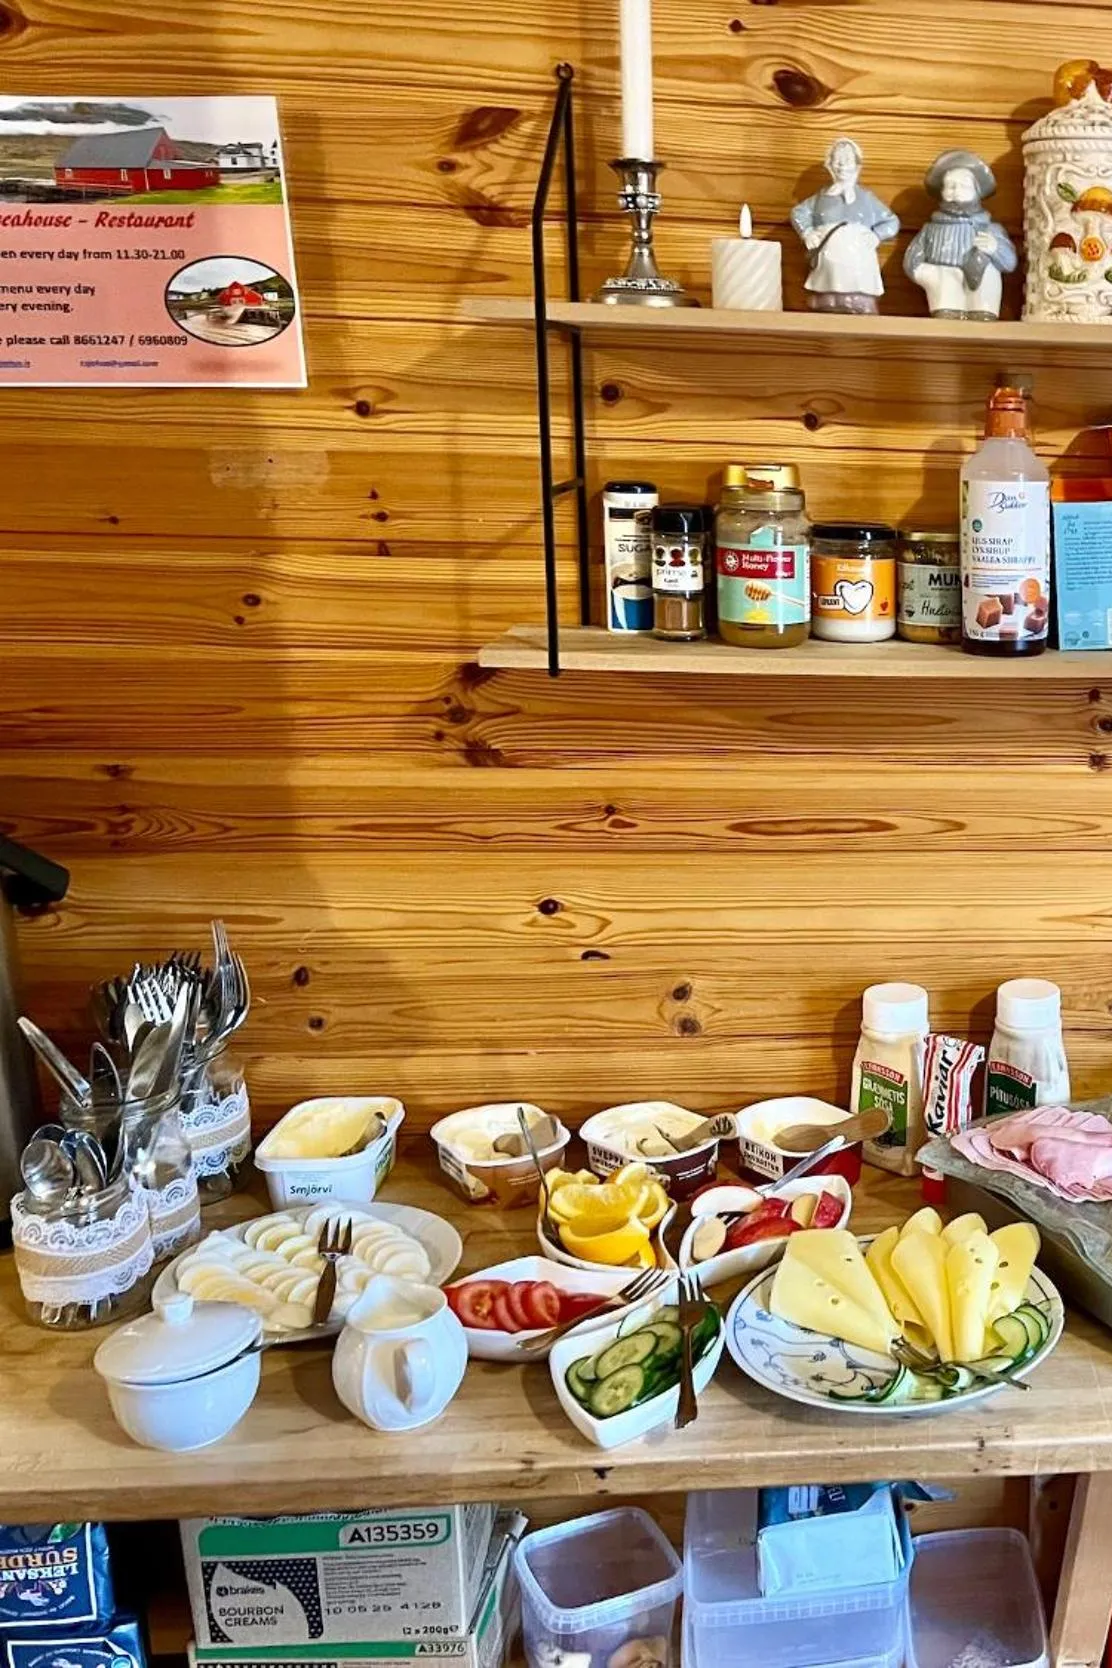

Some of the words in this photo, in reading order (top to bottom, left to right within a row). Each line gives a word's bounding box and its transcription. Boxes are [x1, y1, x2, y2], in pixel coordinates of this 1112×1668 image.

[0, 209, 73, 228] eahouse
[95, 211, 195, 229] Restaurant
[20, 250, 54, 261] every
[57, 249, 79, 261] day
[83, 249, 112, 260] from
[117, 249, 186, 260] 11.30-21.00
[36, 285, 71, 296] every
[74, 283, 96, 296] day
[21, 302, 74, 313] evening.
[6, 335, 46, 347] please
[50, 335, 70, 345] call
[73, 335, 125, 346] 8661247
[138, 336, 188, 346] 6960809
[742, 563, 769, 572] Honey
[927, 1049, 954, 1136] Kaviar
[745, 1142, 776, 1162] BEIKON
[290, 1184, 333, 1197] Smjörvi
[348, 1522, 439, 1543] A135359
[0, 1563, 79, 1581] LEKSAN
[229, 1586, 265, 1595] brakes
[218, 1605, 284, 1616] BOURBON
[225, 1617, 277, 1627] CREAMS
